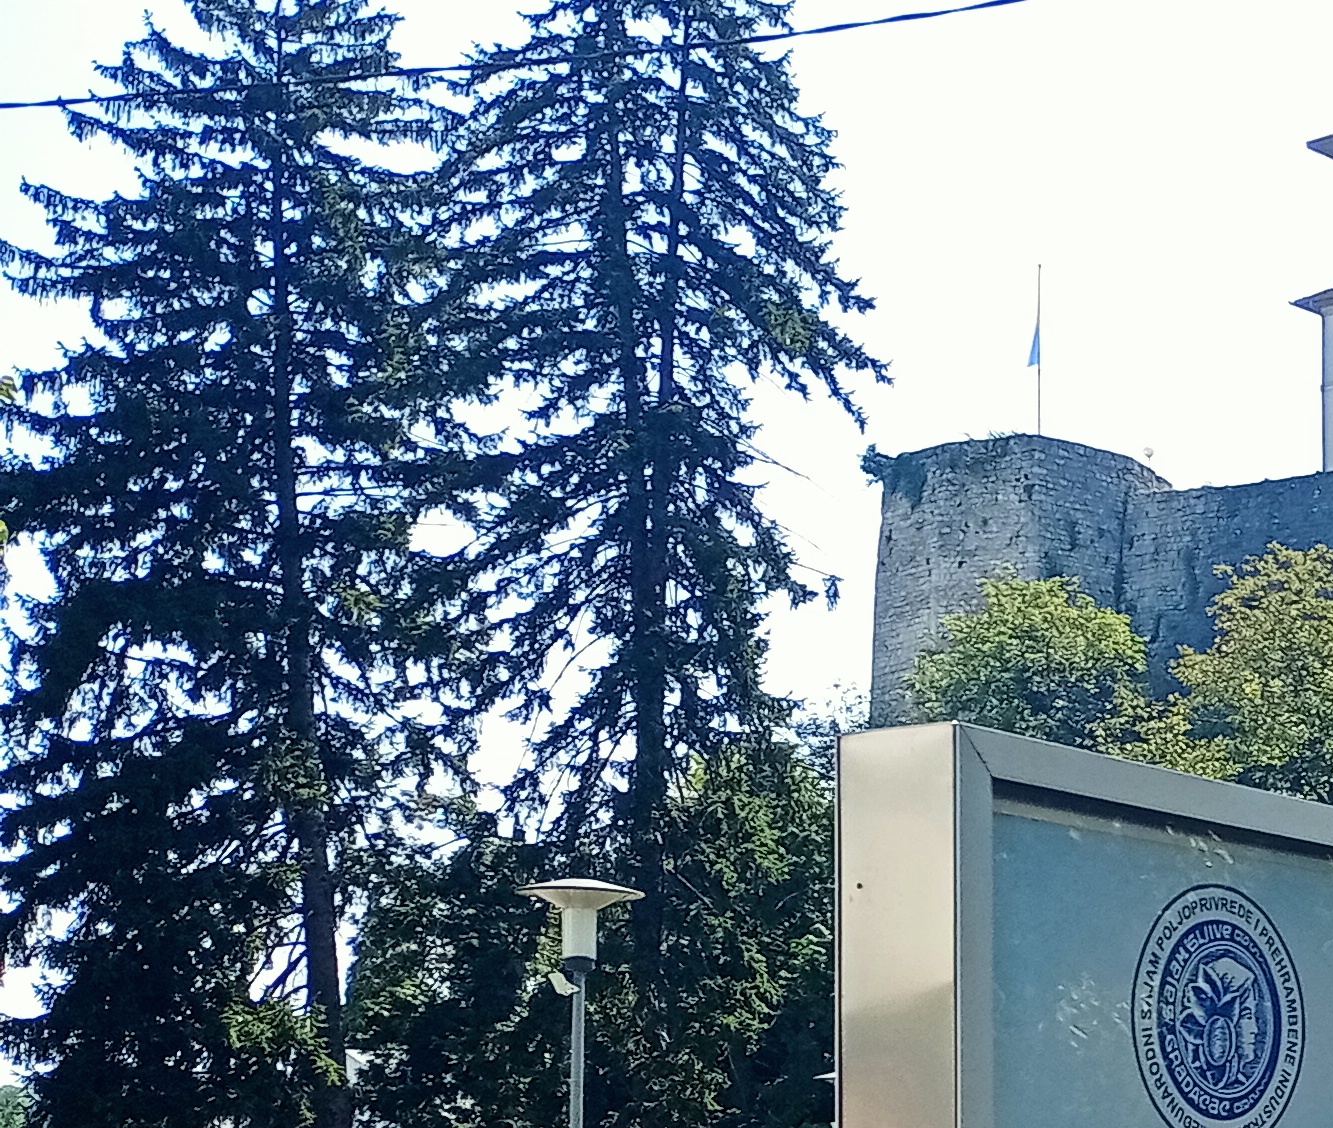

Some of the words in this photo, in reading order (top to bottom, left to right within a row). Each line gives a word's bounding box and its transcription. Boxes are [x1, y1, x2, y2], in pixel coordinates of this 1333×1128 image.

[1140, 950, 1163, 1021] SAJAM
[1155, 896, 1255, 953] POLJOPRIVREDE
[1252, 917, 1260, 932] I
[1258, 926, 1300, 1068] PREHRAMBENE
